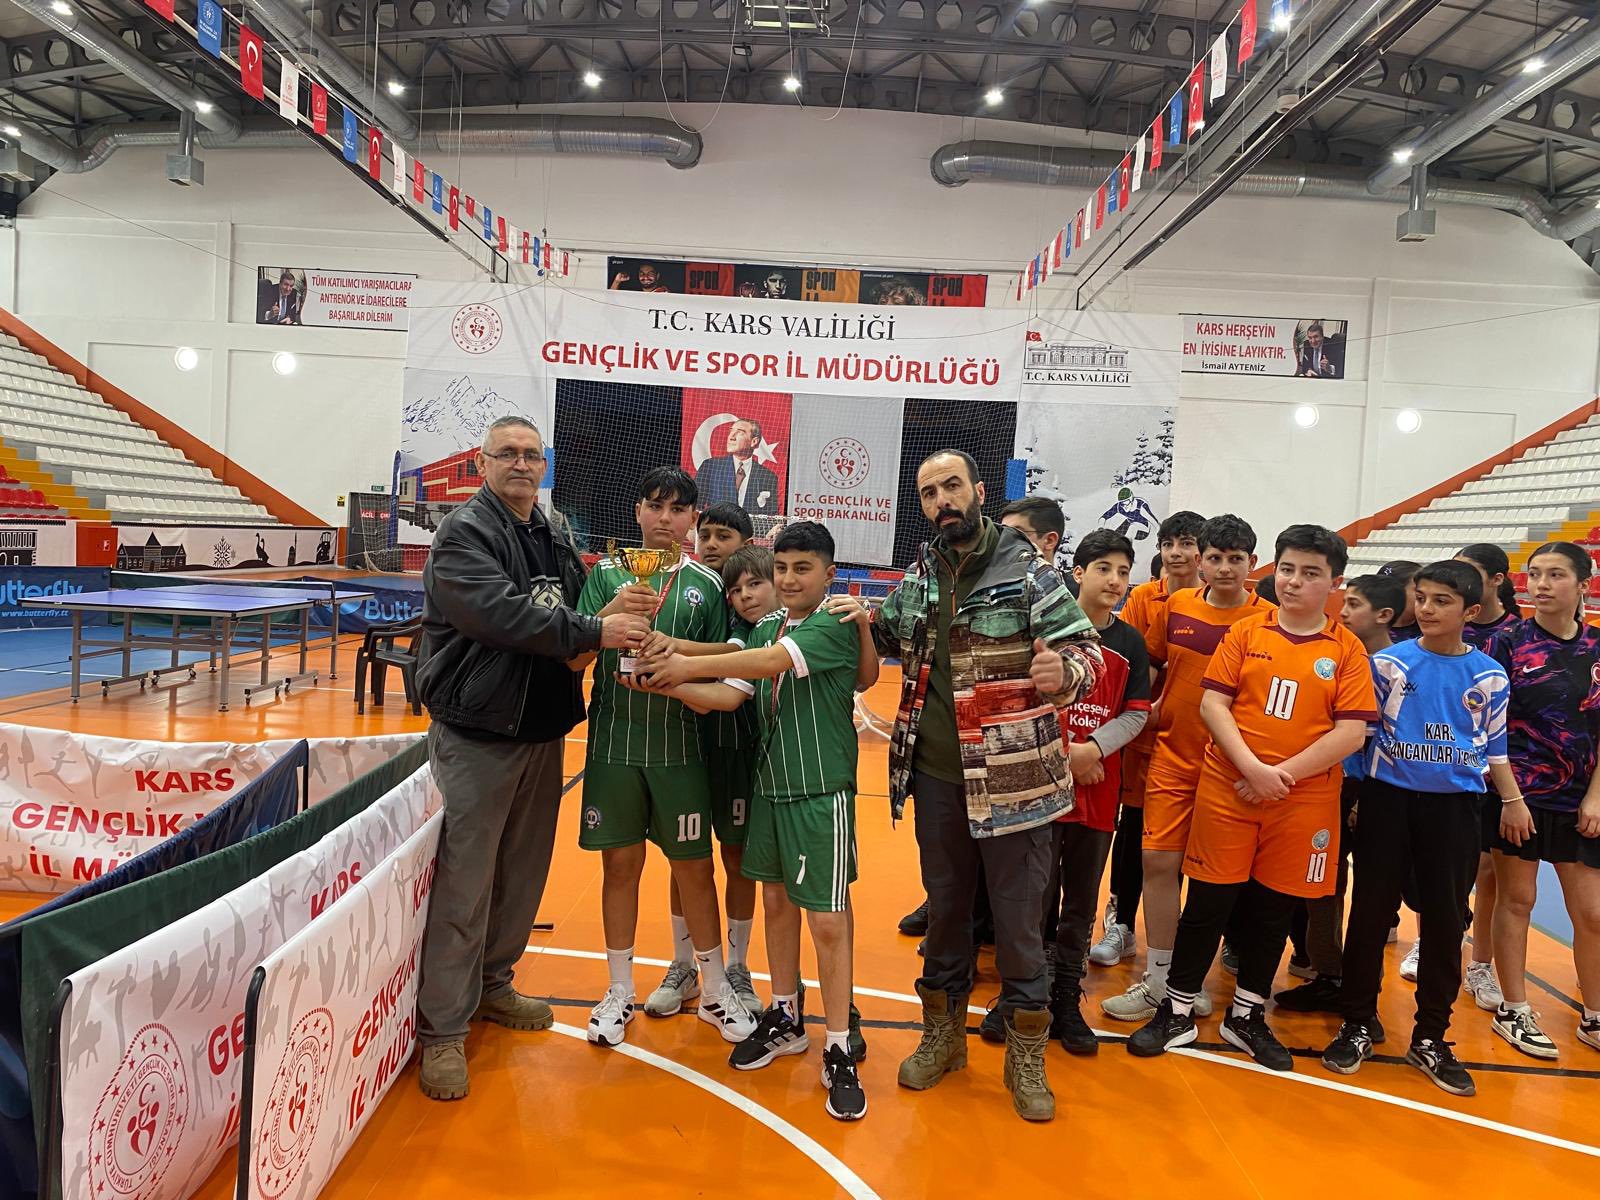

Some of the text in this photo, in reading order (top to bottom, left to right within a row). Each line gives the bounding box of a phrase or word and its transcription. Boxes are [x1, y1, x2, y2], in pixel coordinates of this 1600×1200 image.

[312, 275, 327, 287] TÜM
[327, 277, 360, 289] KATILIMCI
[320, 292, 407, 308] ANTRENÖR VE İDARECİLERE
[328, 310, 393, 323] BAŞARILAR DİLERİM
[649, 308, 896, 341] T.C. KARS VALİLİĞİ
[1196, 322, 1276, 340] KARS HERŞEYİN
[1183, 340, 1287, 359] EN İYİSİNE LAYIKTIR.
[541, 341, 1000, 386] GENÇLİK VE SPOR İL MÜDÜRLÜĞÜ
[1201, 360, 1266, 372] İsmail AYTEMİZ
[1025, 372, 1129, 383] T.C. KARS VALİLİĞİ
[795, 493, 891, 508] T.C. GENÇLİK VE
[794, 507, 890, 523] SPOR BAKANLIĞI
[1264, 674, 1299, 721] 10
[135, 768, 235, 793] KARS
[12, 802, 184, 844] GENÇLİK
[732, 799, 746, 826] 9
[677, 813, 701, 842] 10
[29, 845, 61, 879] İL
[795, 854, 807, 885] 7
[1306, 852, 1328, 883] 10
[412, 856, 438, 918] KAR
[349, 1074, 366, 1132] İL
